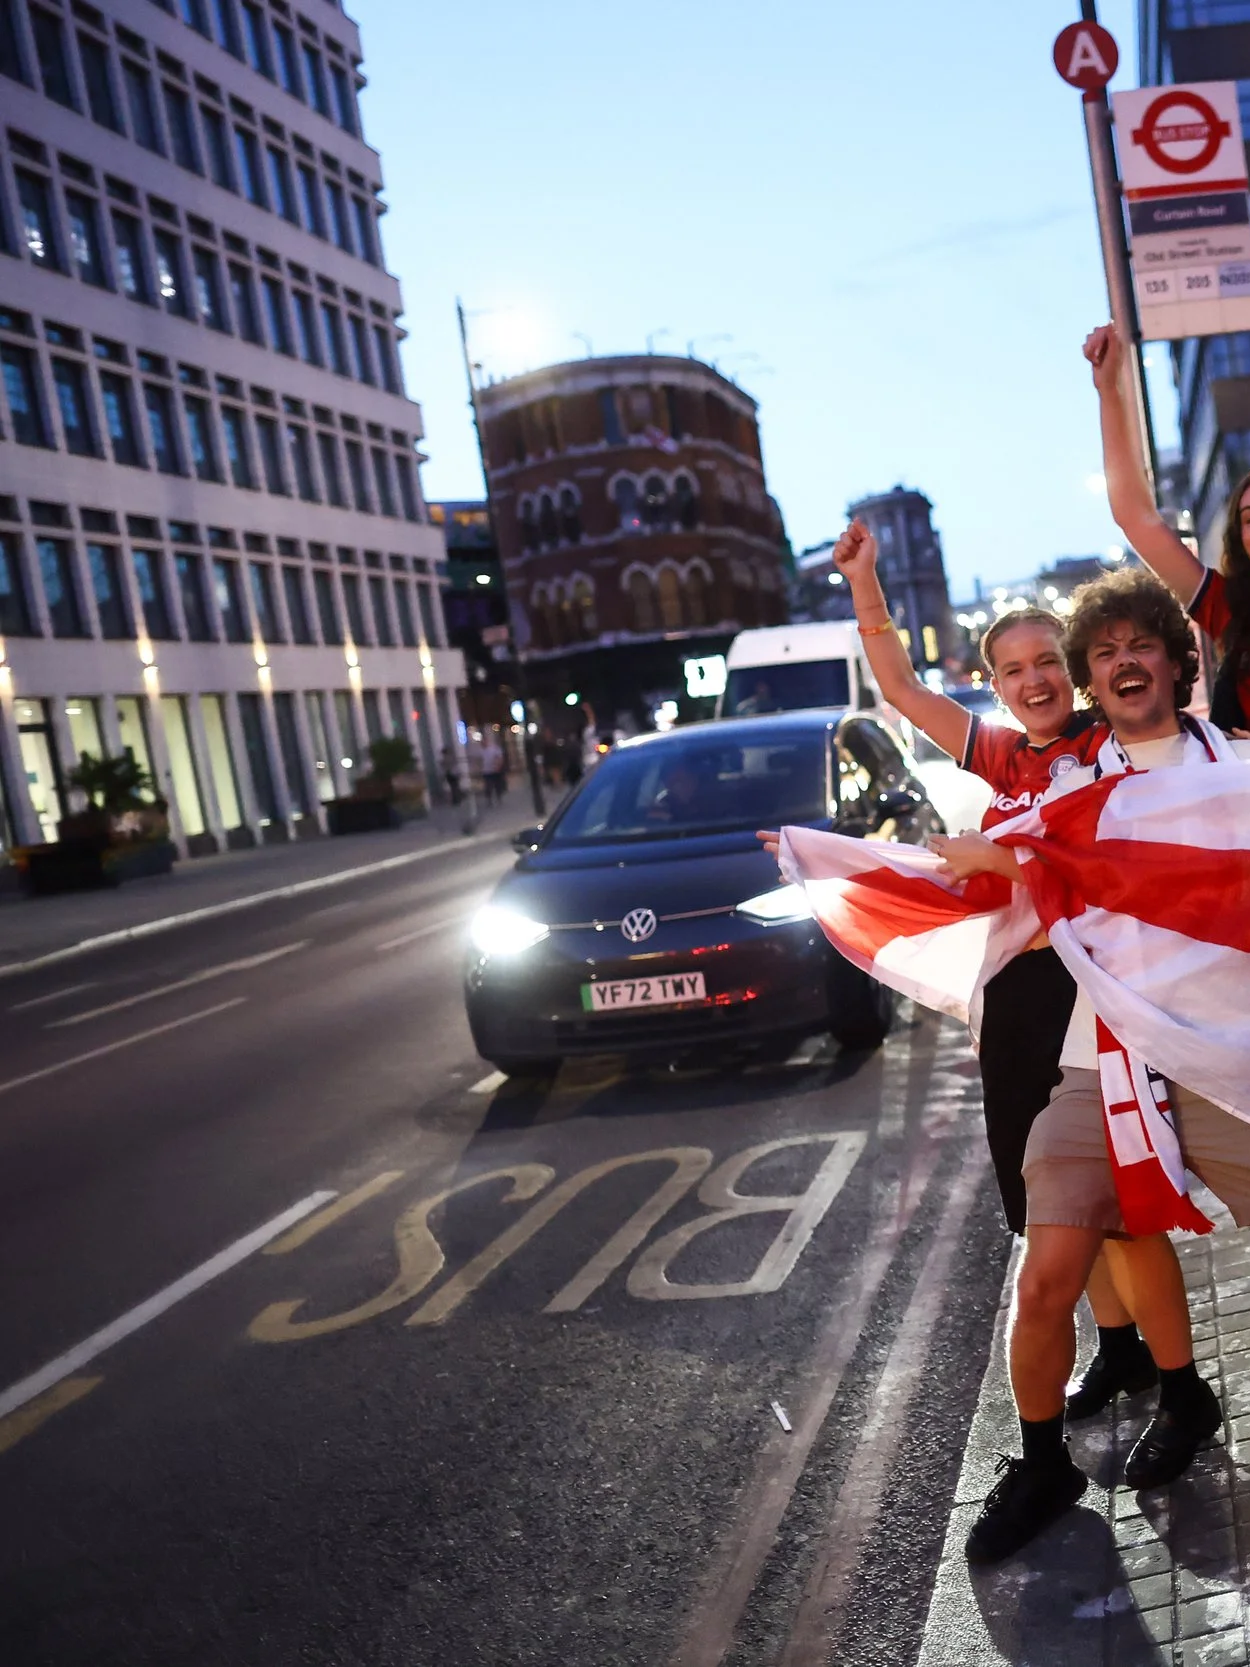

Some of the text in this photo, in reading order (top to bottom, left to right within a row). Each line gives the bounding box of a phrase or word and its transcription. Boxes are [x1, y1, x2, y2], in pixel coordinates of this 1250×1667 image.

[1067, 31, 1110, 78] A
[1152, 124, 1211, 141] BUS STOP
[1153, 204, 1226, 221] Curtain Road
[1144, 246, 1244, 262] Old Street Station
[595, 976, 699, 1005] YF72 TWY
[247, 1130, 868, 1343] BUS
